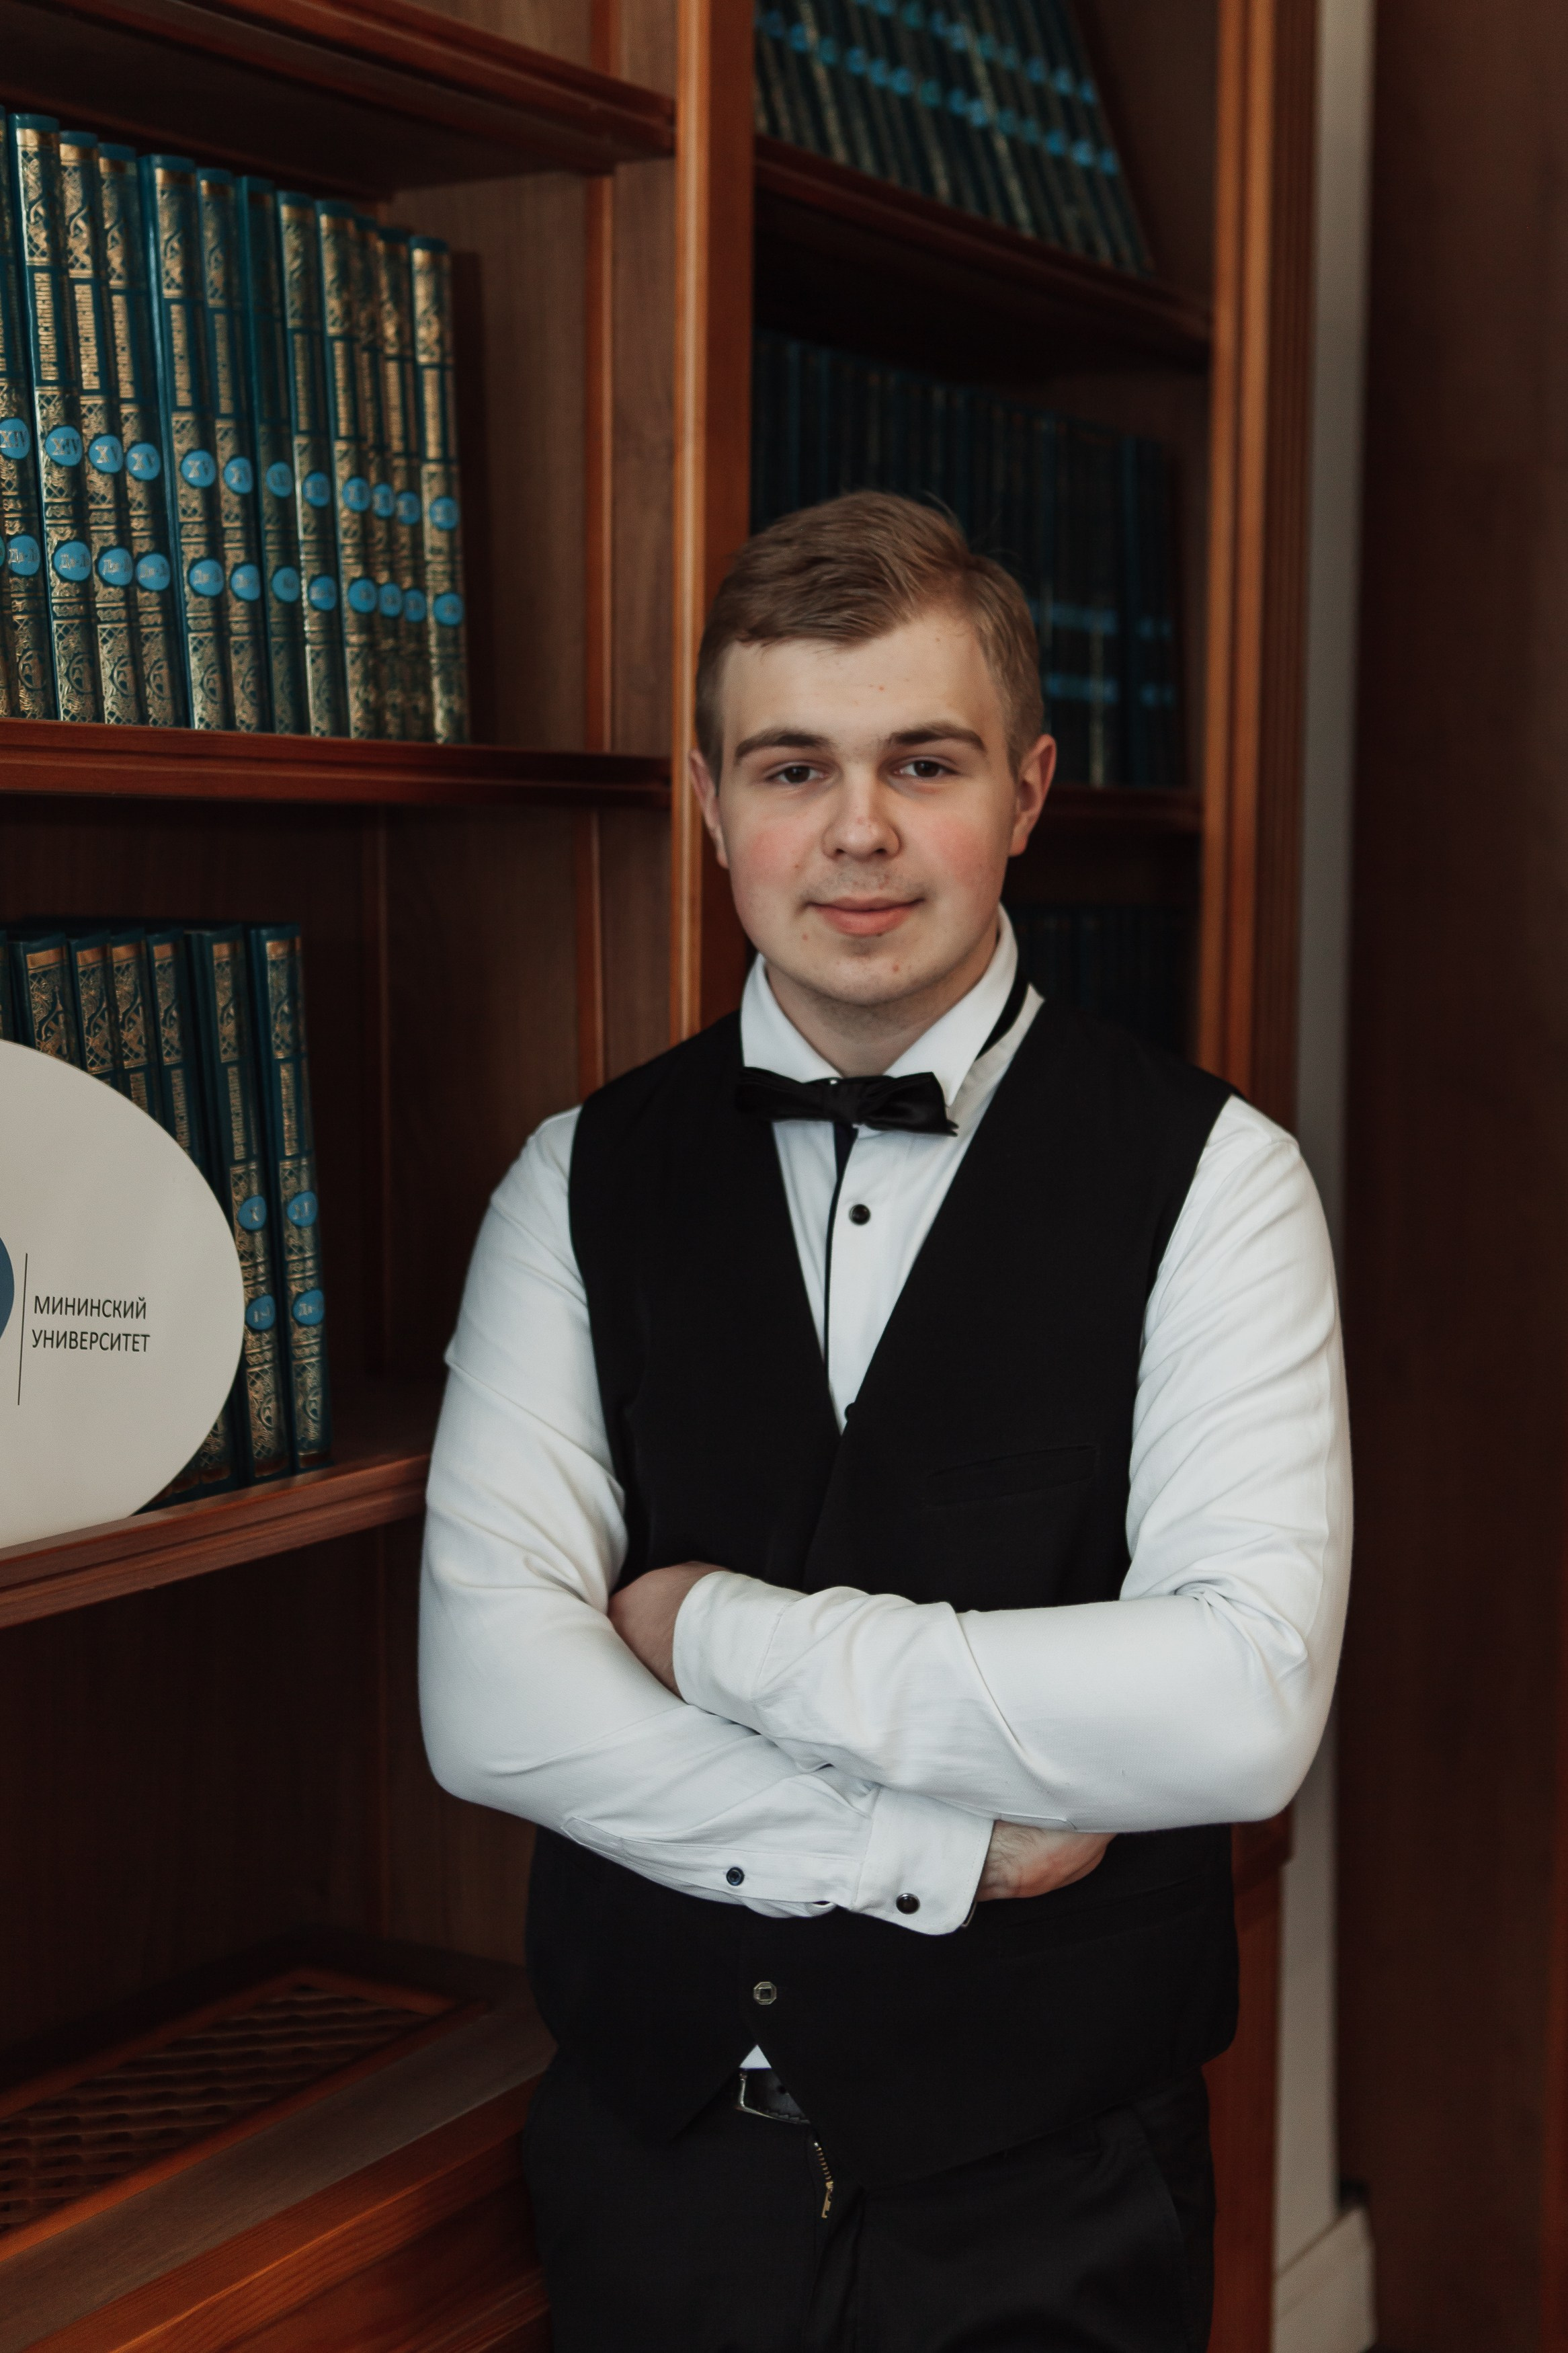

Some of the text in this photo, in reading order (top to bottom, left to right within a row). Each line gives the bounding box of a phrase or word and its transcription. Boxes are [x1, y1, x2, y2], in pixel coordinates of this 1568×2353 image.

[34, 272, 58, 381] ПРАВОСЛАВНАЯ
[34, 1295, 147, 1320] МИНИНСКИЙ
[32, 1328, 151, 1353] УНИВЕРСИТЕТ
